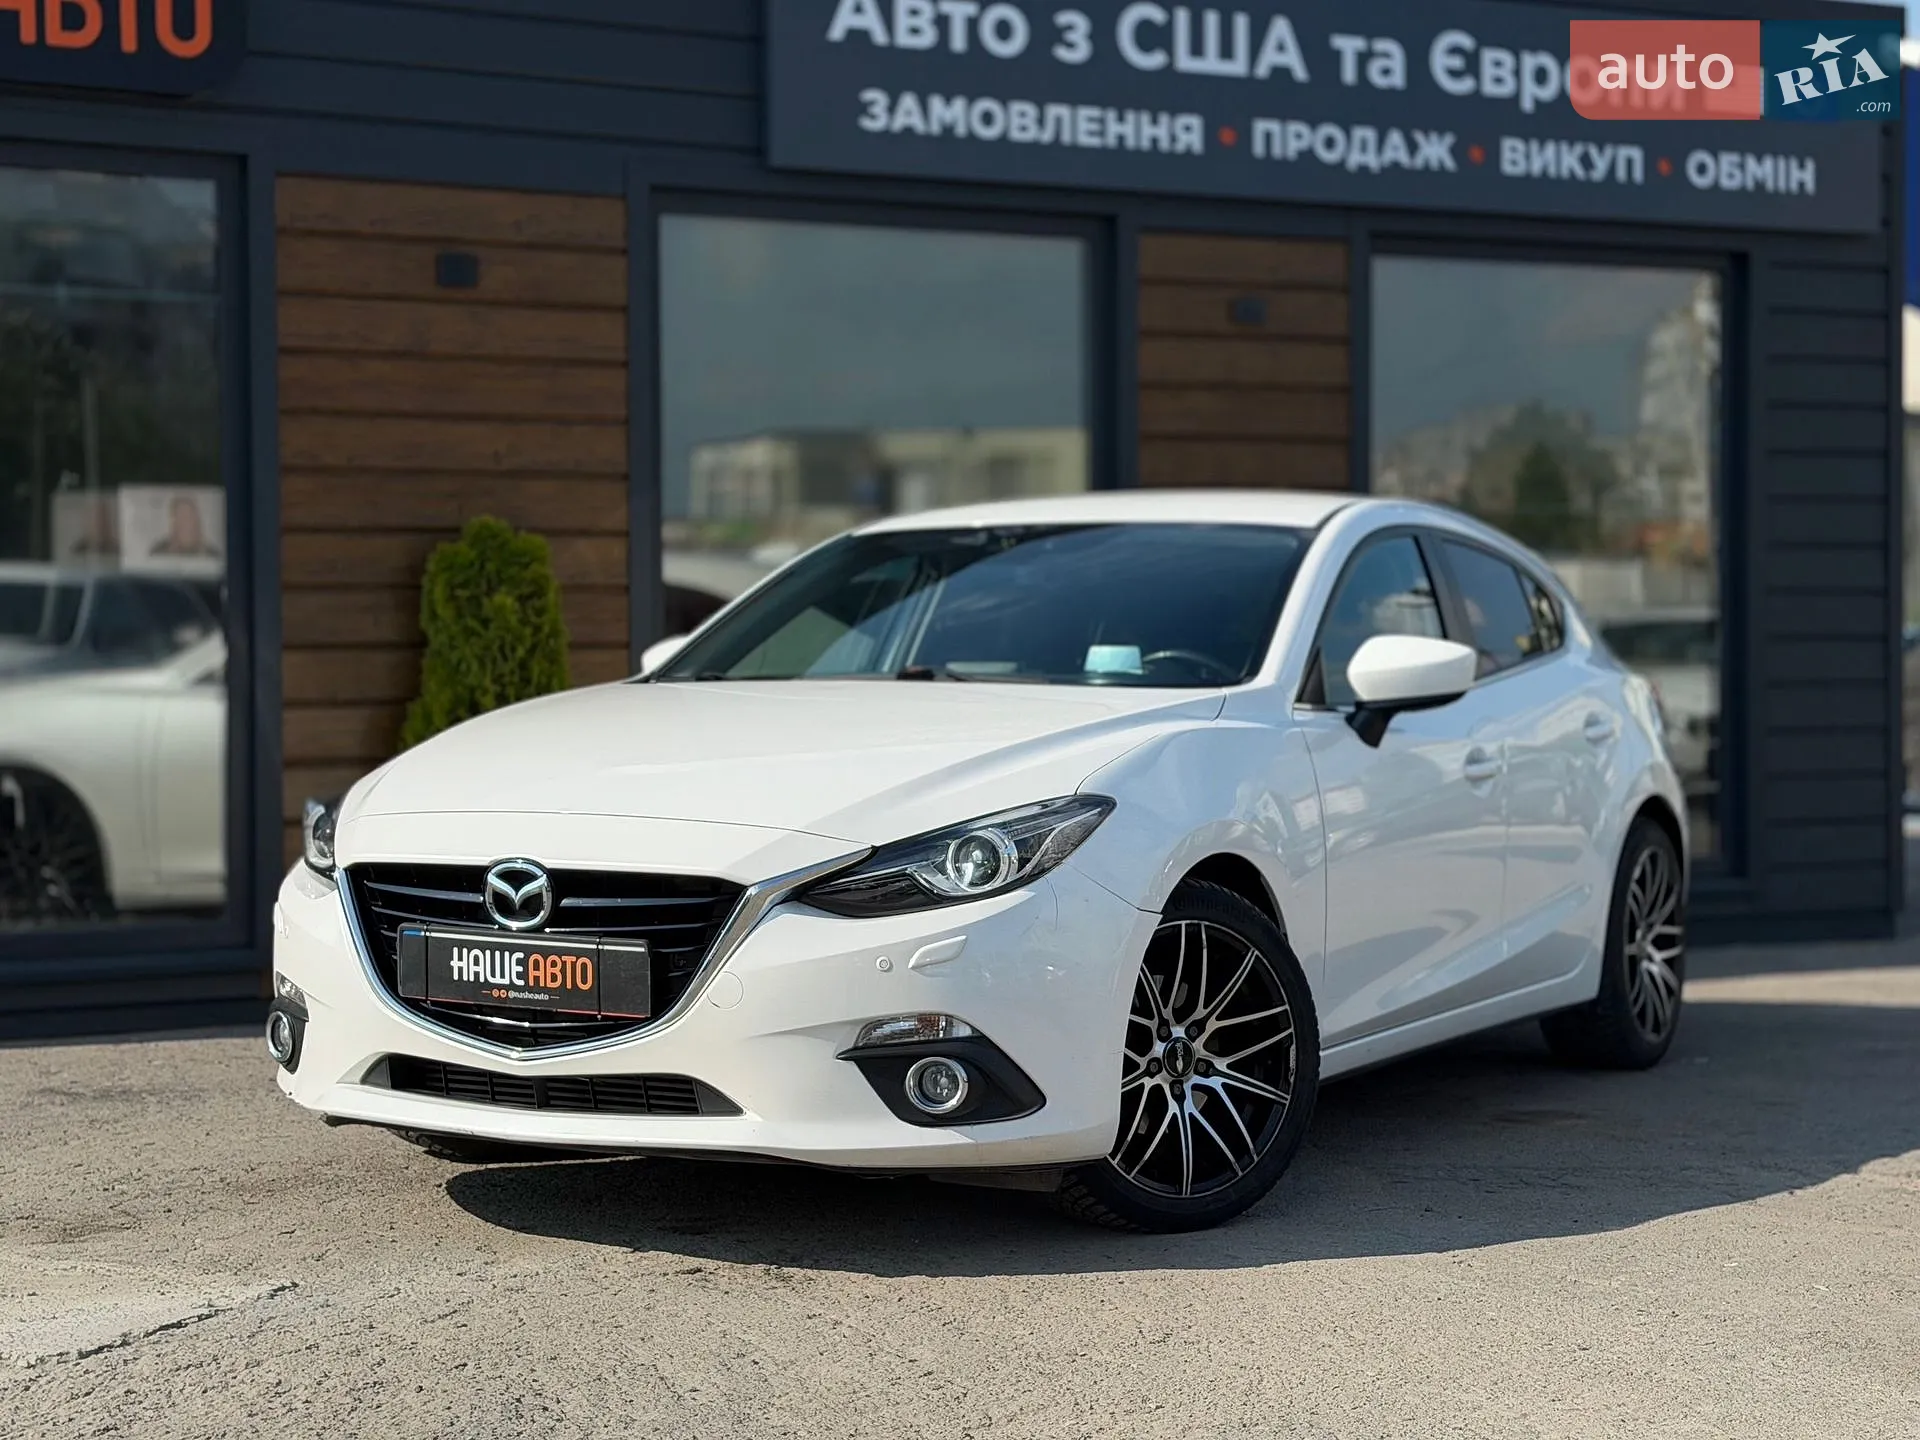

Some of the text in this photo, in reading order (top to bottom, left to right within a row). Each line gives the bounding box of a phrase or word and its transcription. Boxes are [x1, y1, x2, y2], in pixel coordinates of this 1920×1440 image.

[826, 0, 1031, 58] Авто
[1115, 1, 1309, 83] США
[1330, 33, 1408, 91] та
[857, 87, 1816, 195] ЗАМОВЛЕННЯ ПРОДАЖ ВИКУП ОБМІН
[450, 946, 593, 990] НАШЕ АВТО
